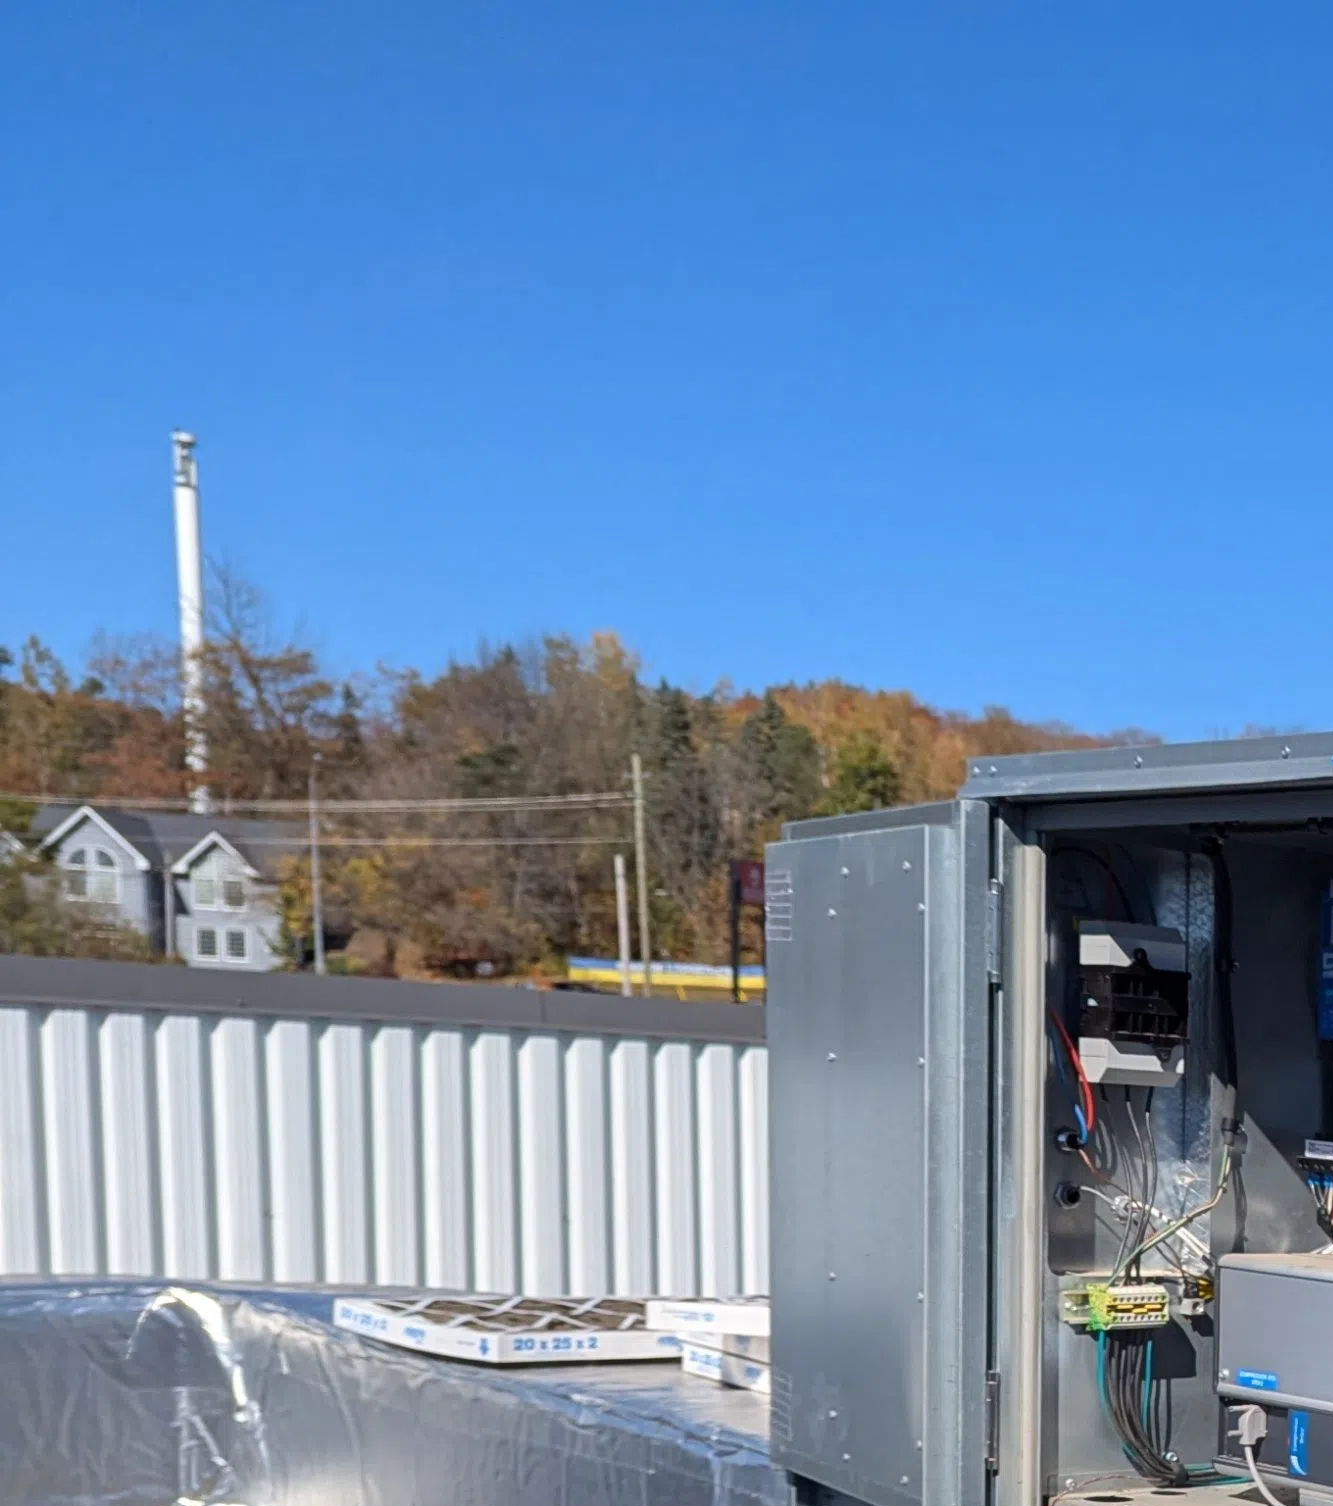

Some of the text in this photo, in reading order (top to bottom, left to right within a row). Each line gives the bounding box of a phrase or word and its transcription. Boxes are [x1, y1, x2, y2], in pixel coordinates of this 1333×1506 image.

[513, 1337, 534, 1351] 20
[552, 1337, 572, 1350] 25
[588, 1336, 598, 1349] 2
